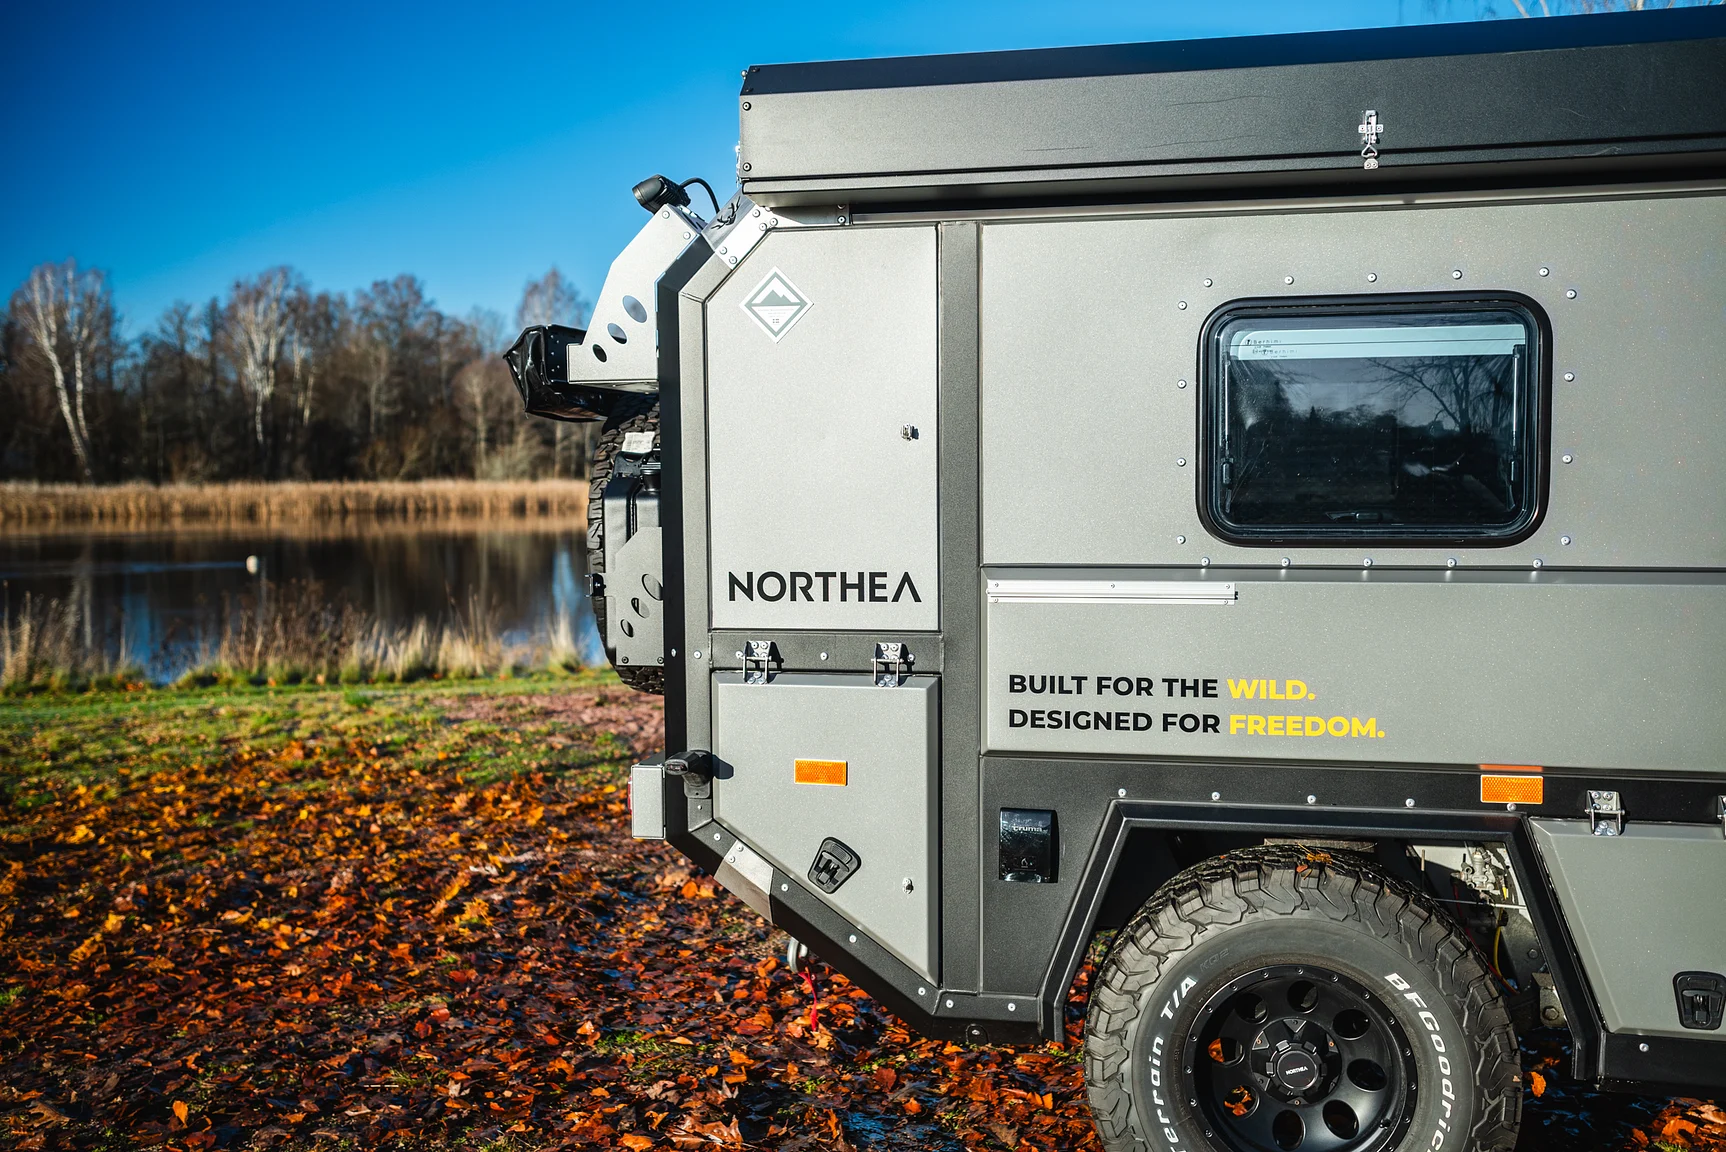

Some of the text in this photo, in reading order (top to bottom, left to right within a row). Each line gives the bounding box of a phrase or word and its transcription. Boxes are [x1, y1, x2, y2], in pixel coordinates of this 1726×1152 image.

[728, 571, 922, 603] NORTHEA
[1008, 674, 1316, 700] BUILT FOR THE WILD.
[1008, 709, 1385, 738] DESIGNED FOR FREEDOM.
[1160, 976, 1198, 1020] T/A
[1384, 972, 1456, 1152] BFGoodric
